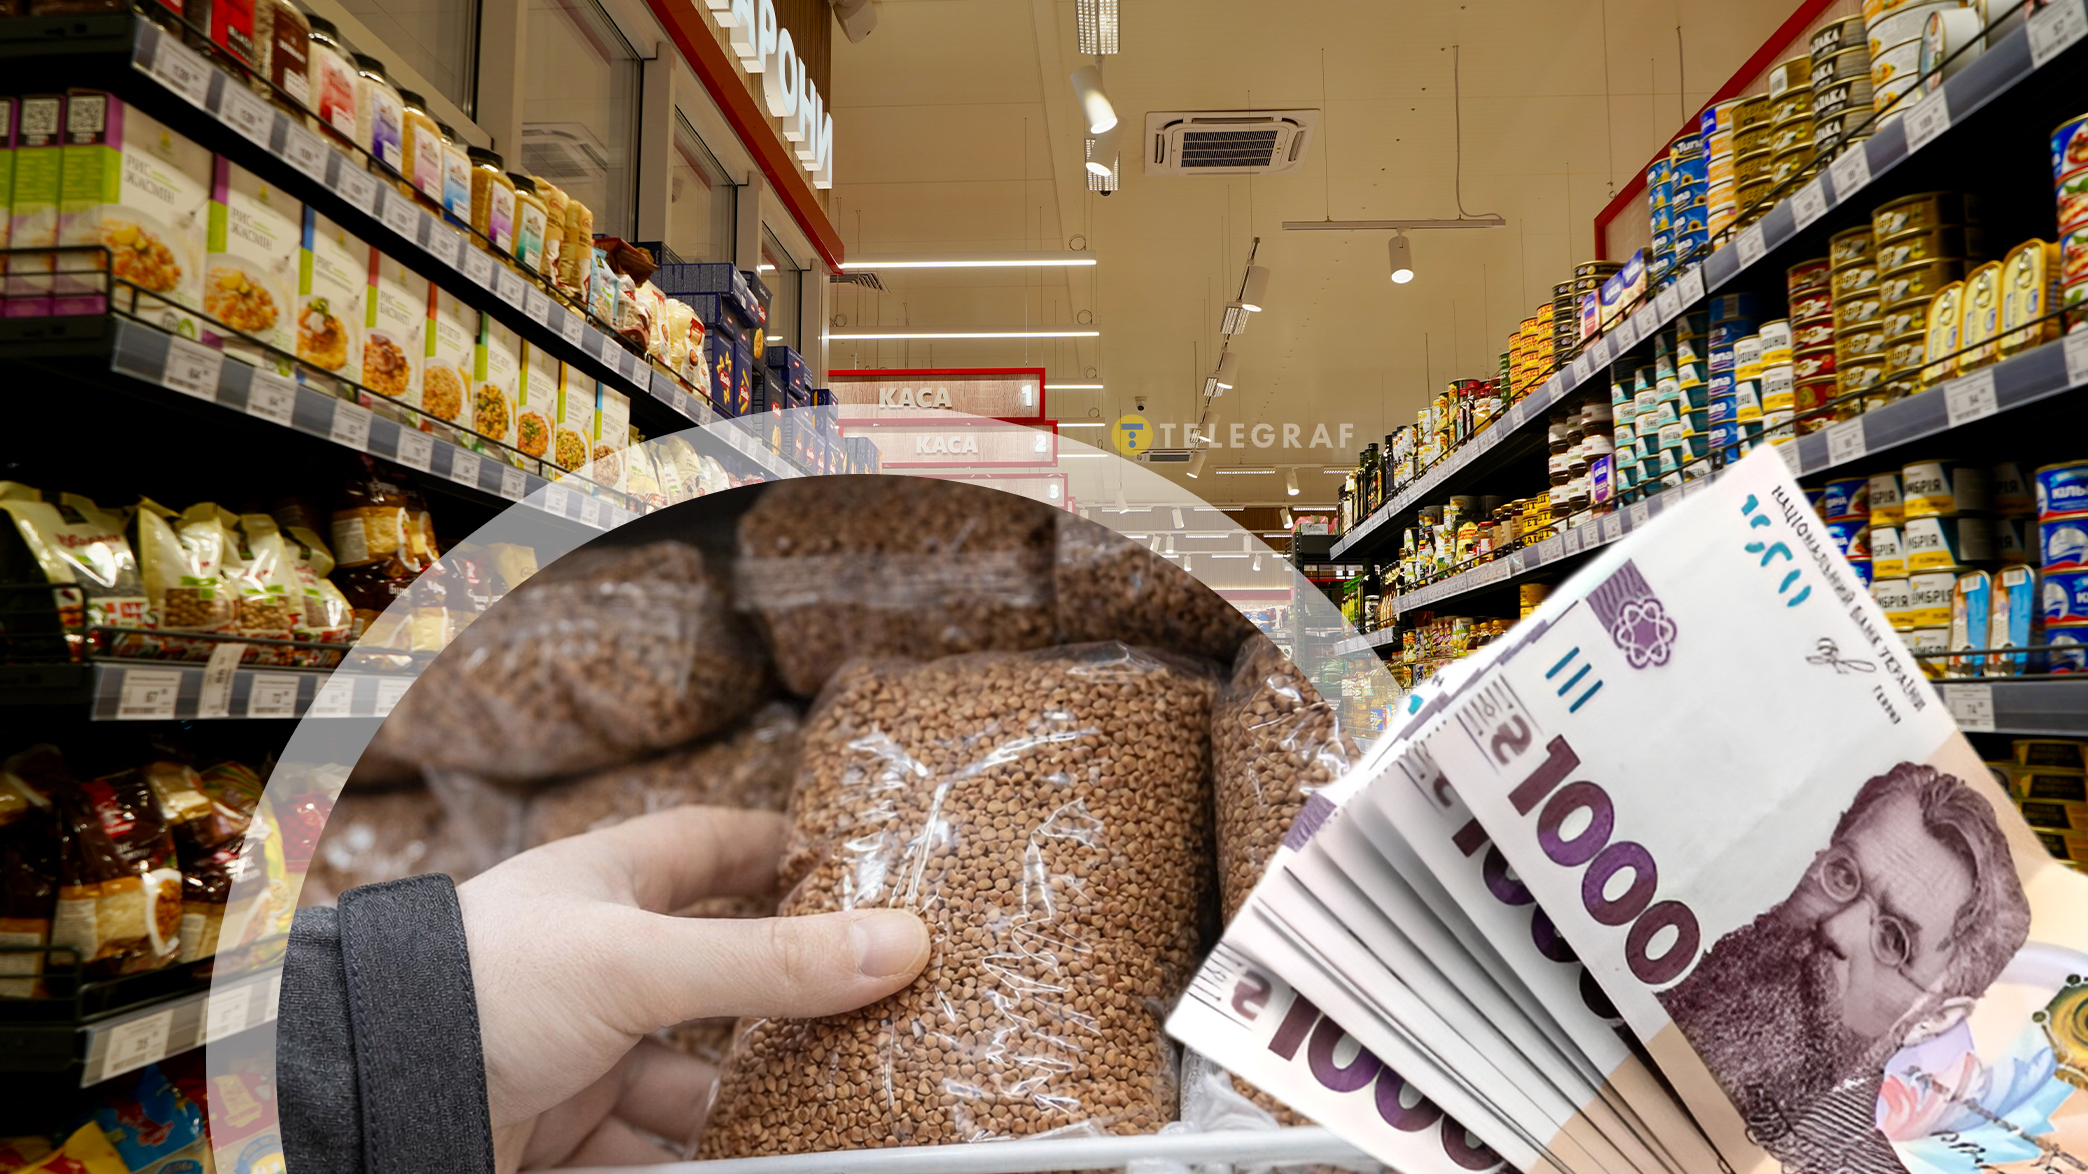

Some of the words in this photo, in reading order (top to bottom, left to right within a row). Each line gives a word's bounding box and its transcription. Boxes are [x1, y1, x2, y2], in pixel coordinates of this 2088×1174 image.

[713, 0, 833, 190] АРОНИ
[879, 388, 952, 408] КАСА
[1021, 385, 1033, 407] 1
[916, 436, 978, 454] КАСА
[1035, 434, 1047, 453] 2
[1049, 484, 1059, 500] 3
[1508, 734, 1700, 985] 1000
